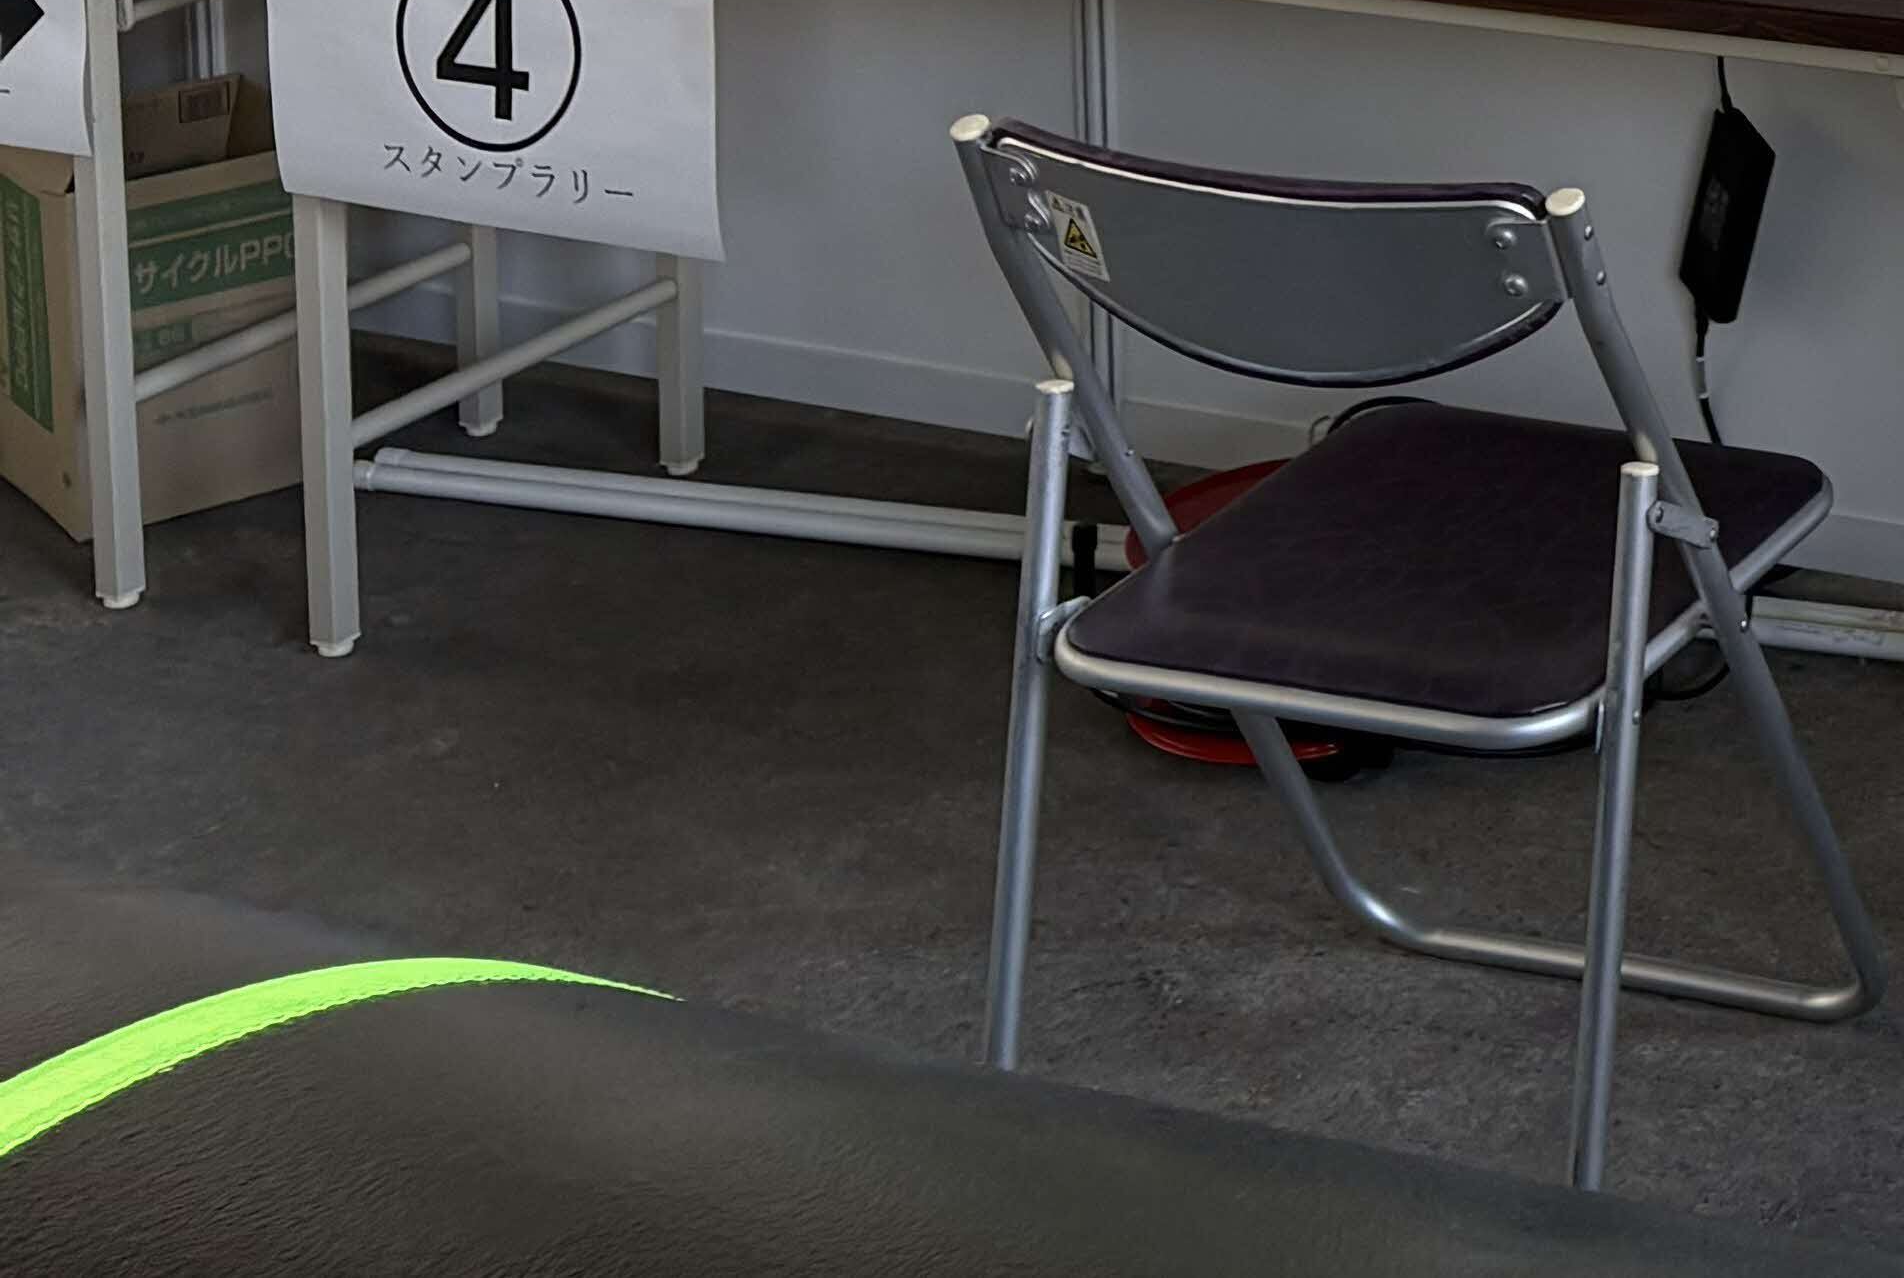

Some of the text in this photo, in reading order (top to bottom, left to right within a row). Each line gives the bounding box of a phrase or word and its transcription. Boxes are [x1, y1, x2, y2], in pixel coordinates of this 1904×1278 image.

[383, 143, 635, 206] スタンプラリー
